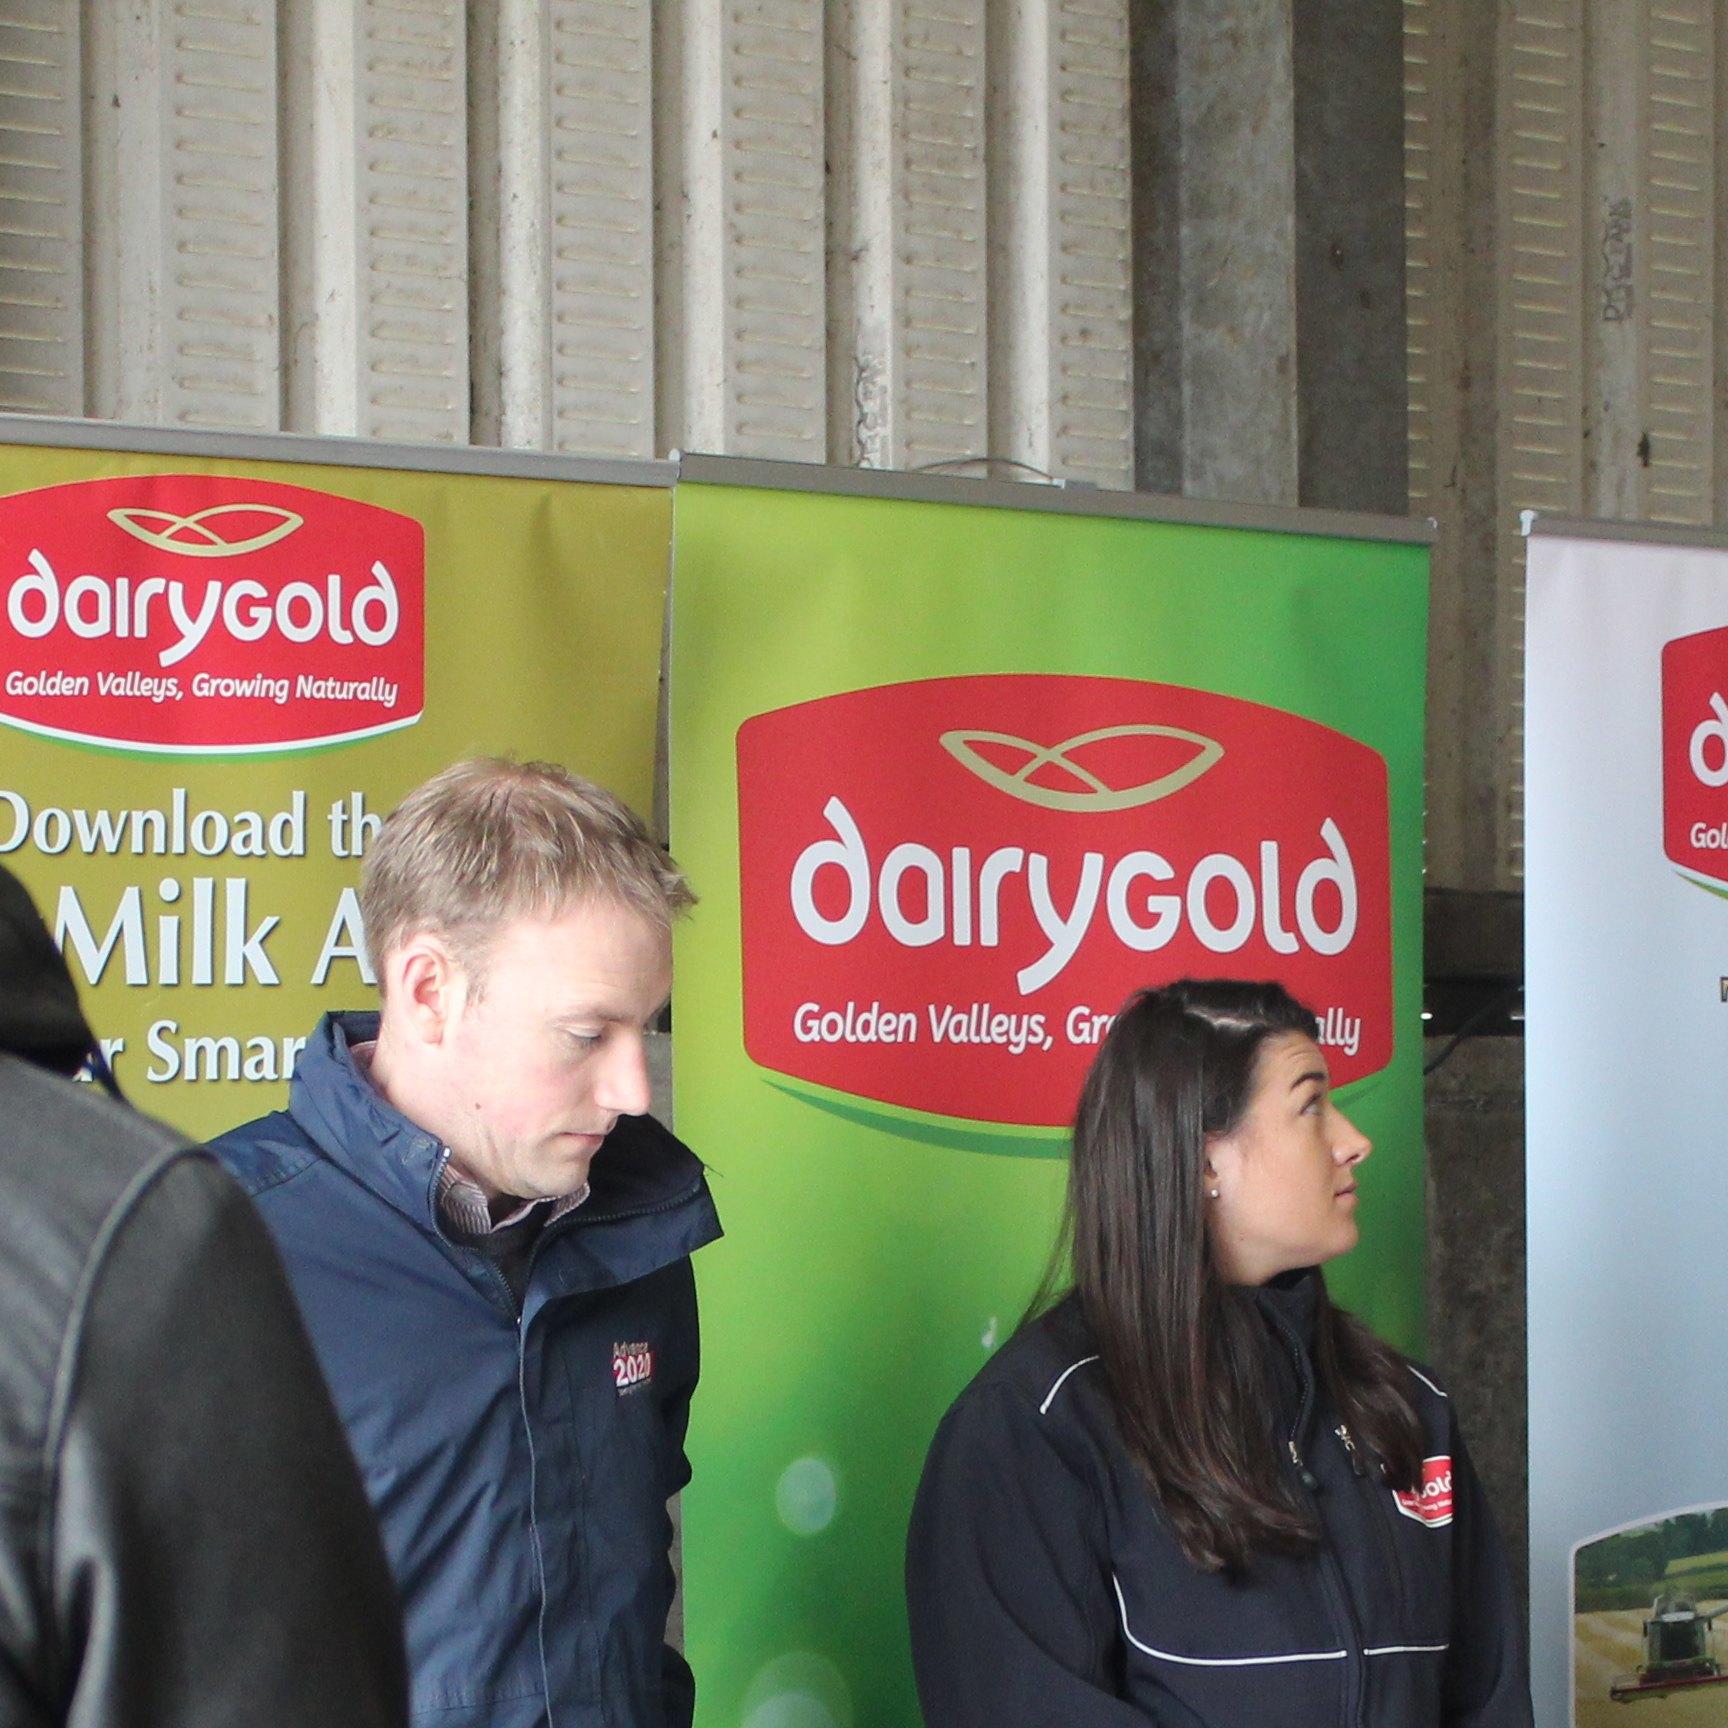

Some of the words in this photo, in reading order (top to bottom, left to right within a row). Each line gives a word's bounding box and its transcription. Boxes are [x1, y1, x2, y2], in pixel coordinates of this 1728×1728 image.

[5, 671, 89, 698] Golden
[96, 673, 184, 703] Valleys,
[192, 674, 289, 704] Growing
[295, 674, 399, 708] Naturally
[53, 876, 282, 987] Milk
[793, 1000, 918, 1045] Golden
[926, 1003, 1054, 1056] Valleys,
